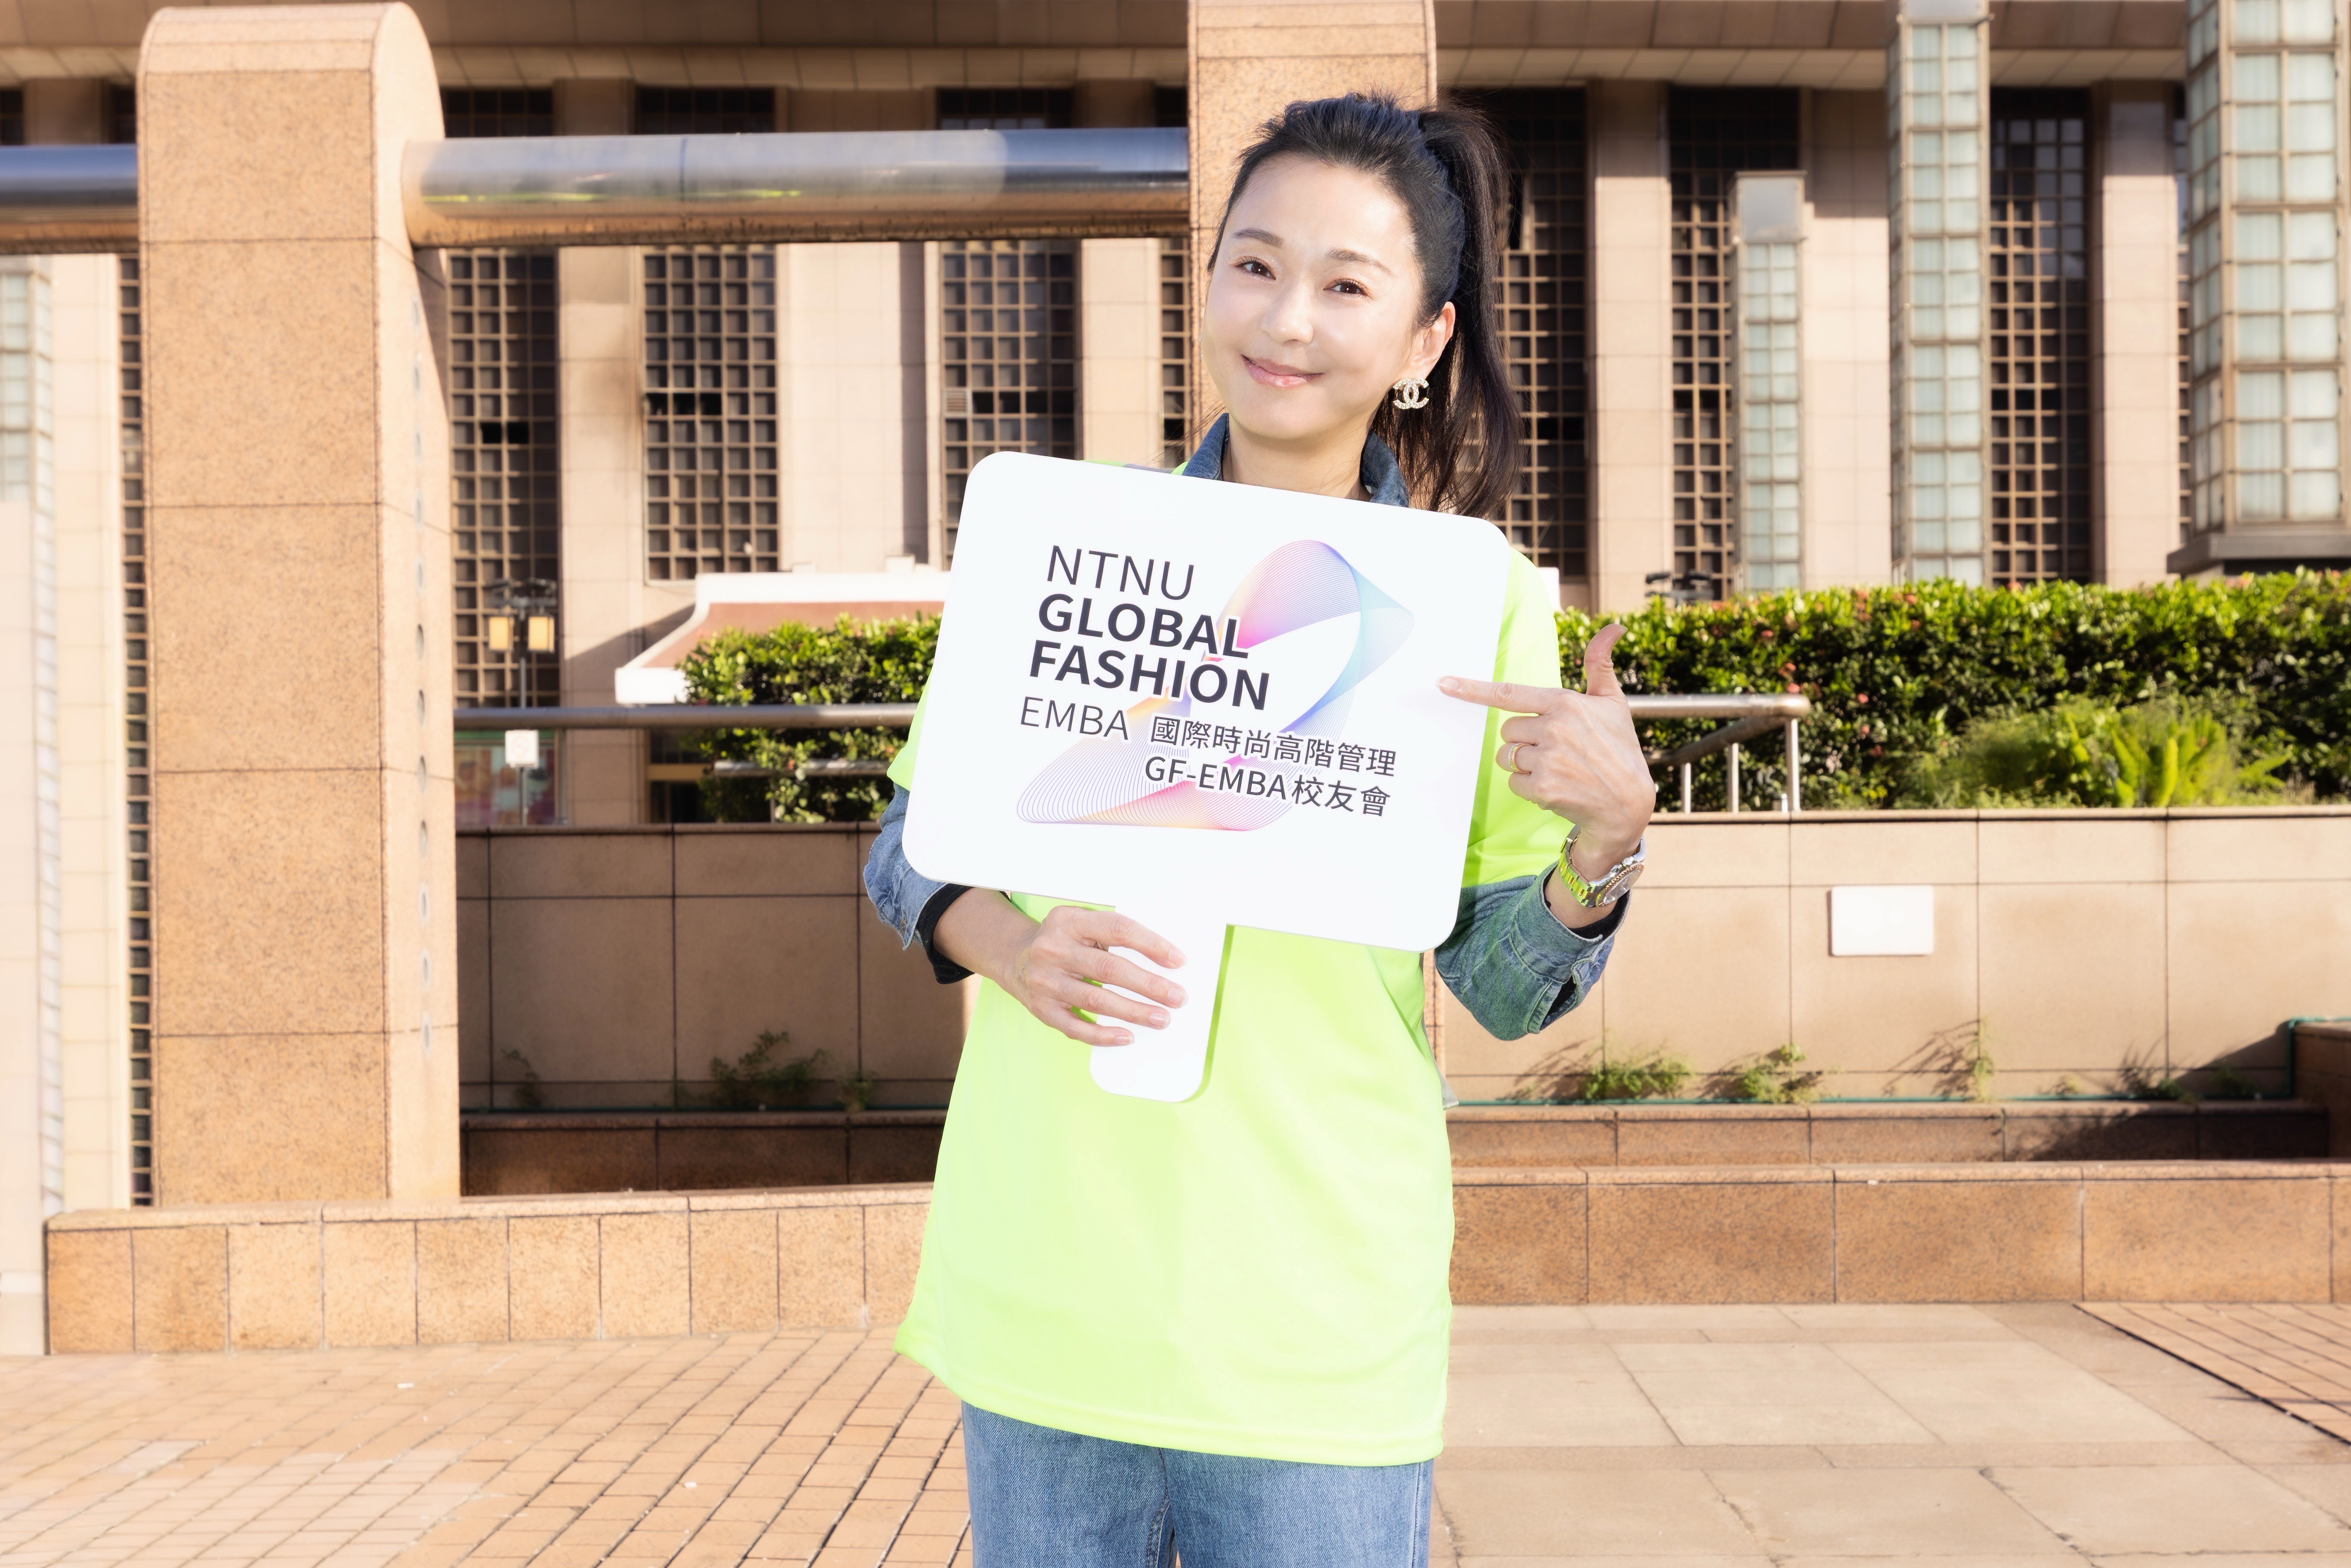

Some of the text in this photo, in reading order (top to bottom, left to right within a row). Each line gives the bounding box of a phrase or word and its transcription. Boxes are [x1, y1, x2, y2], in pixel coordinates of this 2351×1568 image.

[1046, 545, 1194, 601] NTNU
[1038, 593, 1249, 659] GLOBAL
[1029, 639, 1270, 711] FASHION
[1020, 696, 1397, 777] EMBA 國際時尚高階管理
